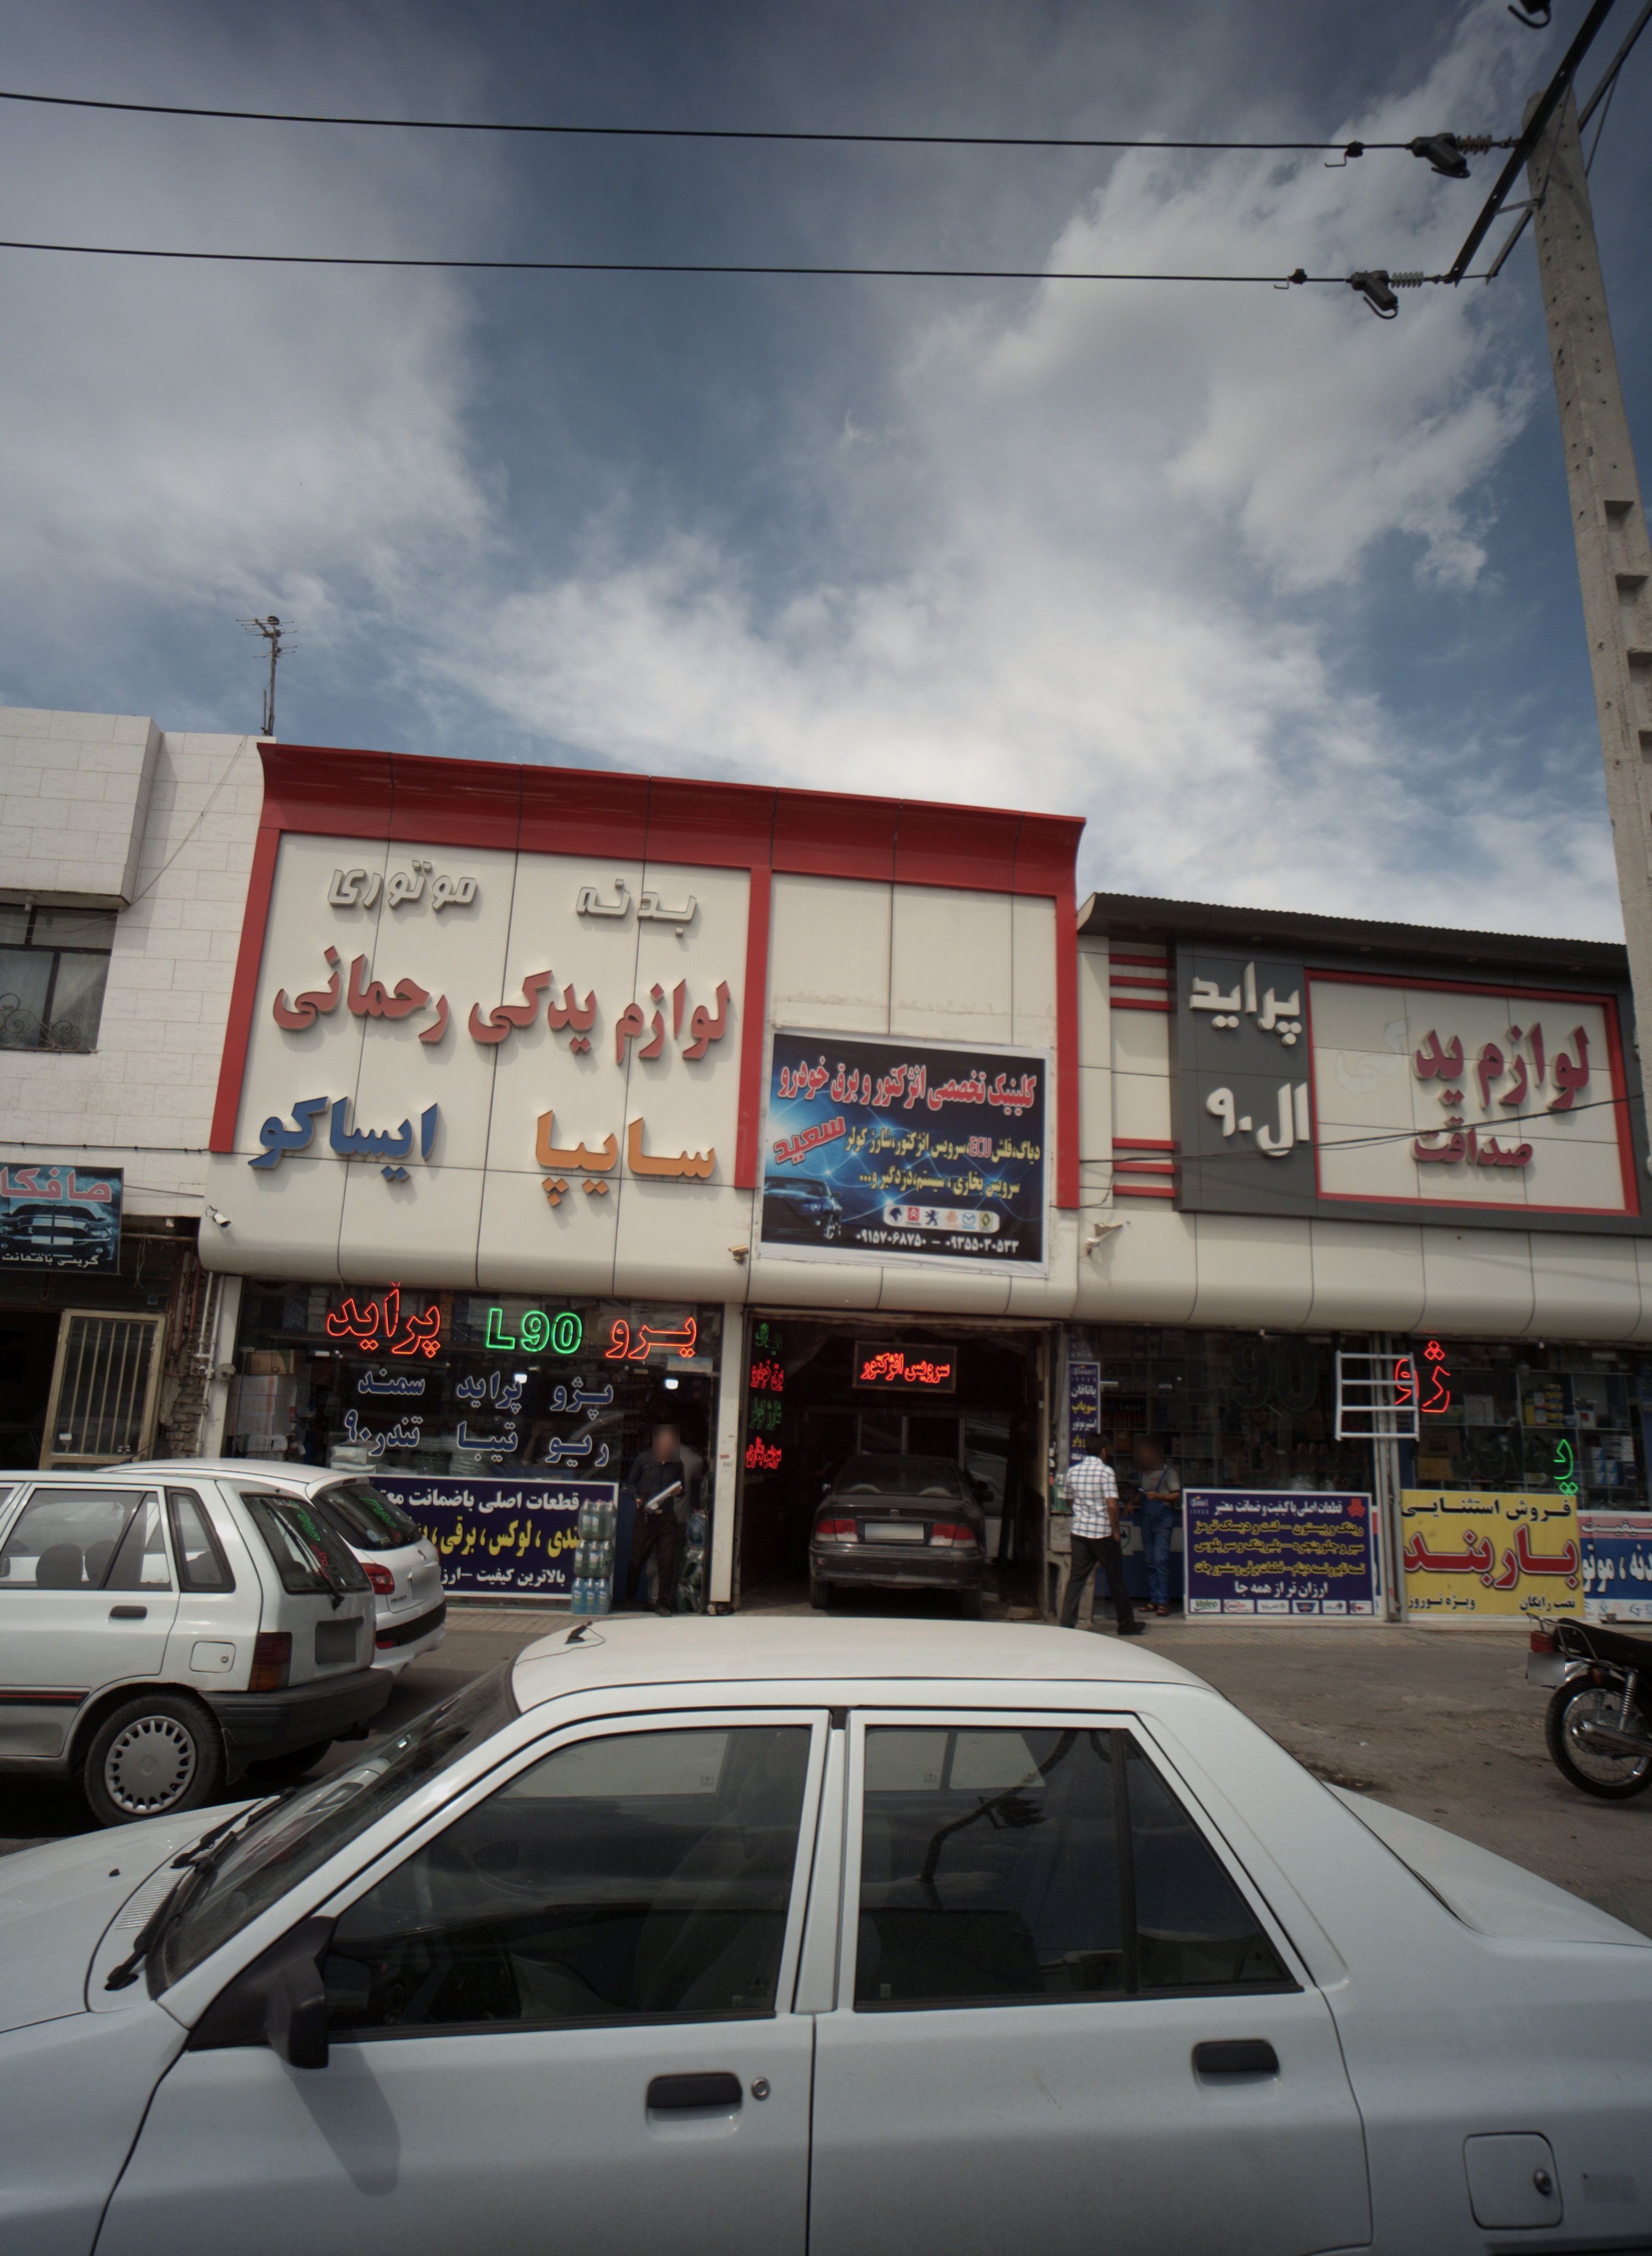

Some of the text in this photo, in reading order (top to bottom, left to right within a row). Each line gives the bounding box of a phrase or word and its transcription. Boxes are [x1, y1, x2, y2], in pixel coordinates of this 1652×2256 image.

[327, 860, 477, 910] موتوری
[577, 879, 697, 936] بدنه
[273, 946, 730, 1064] لوازم یدکی رحمانی
[1189, 961, 1303, 1047] پراید
[1477, 1022, 1590, 1110] لوازم
[778, 1056, 1037, 1116] کلینیک تخصصی انژکتور و برق خودرو
[248, 1096, 441, 1183] ایساکو
[774, 1116, 846, 1164] سعید
[845, 1126, 868, 1152] کولر
[1412, 1116, 1534, 1168] صداقت
[536, 1109, 716, 1207] سایپا
[953, 1171, 983, 1196] بخاری
[986, 1179, 1020, 1200] سرویس
[327, 1287, 441, 1359] پراید
[486, 1305, 583, 1354] L90
[860, 1352, 950, 1384] سرویس انژکتور
[357, 1368, 615, 1420] پژو پراید سمند
[457, 1420, 518, 1462] تیبا
[545, 1434, 610, 1467] ریو
[478, 1491, 523, 1514] اصلی
[526, 1492, 580, 1511] قطعات
[1297, 1501, 1317, 1517] اصلی
[1506, 1500, 1572, 1521] فروش
[440, 1516, 477, 1555] برقی
[488, 1519, 532, 1557] لوکس
[1403, 1524, 1578, 1589] باربند
[476, 1568, 515, 1585] کیفیت
[517, 1569, 566, 1587] بالاترین
[1235, 1580, 1249, 1597] جا
[1251, 1584, 1272, 1593] همه
[1274, 1581, 1284, 1598] از
[1298, 1581, 1328, 1598] ارزان
[1408, 1593, 1475, 1609] ویژه نوروز
[1519, 1596, 1575, 1611] نصب رایگان
